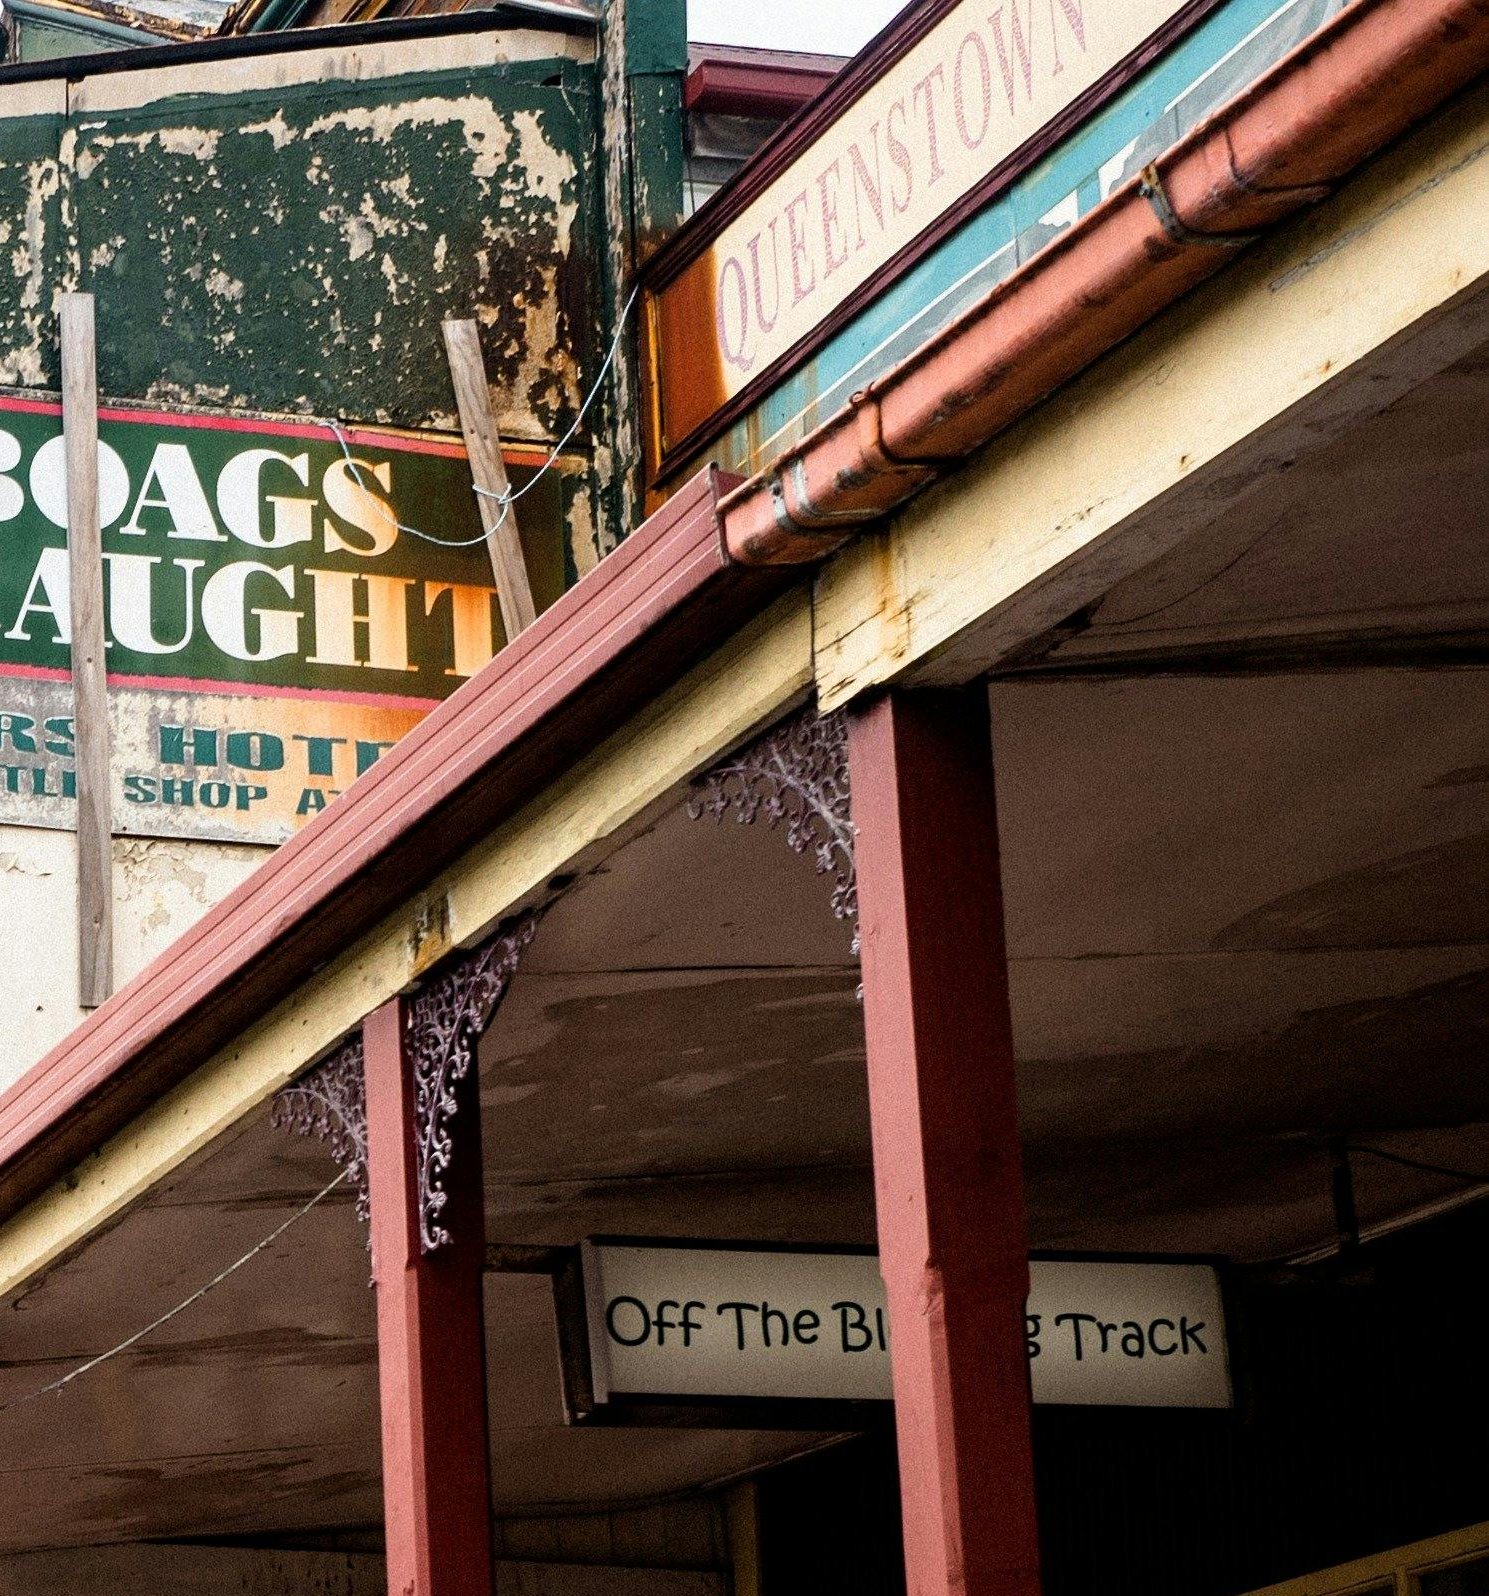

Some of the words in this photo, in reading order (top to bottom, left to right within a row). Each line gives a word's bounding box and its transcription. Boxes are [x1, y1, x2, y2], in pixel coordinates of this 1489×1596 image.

[715, 0, 1087, 373] QUEENSTOWN
[123, 774, 267, 811] SHOP
[604, 1296, 707, 1348] Off
[716, 1301, 821, 1351] The
[1055, 1312, 1209, 1361] Track
